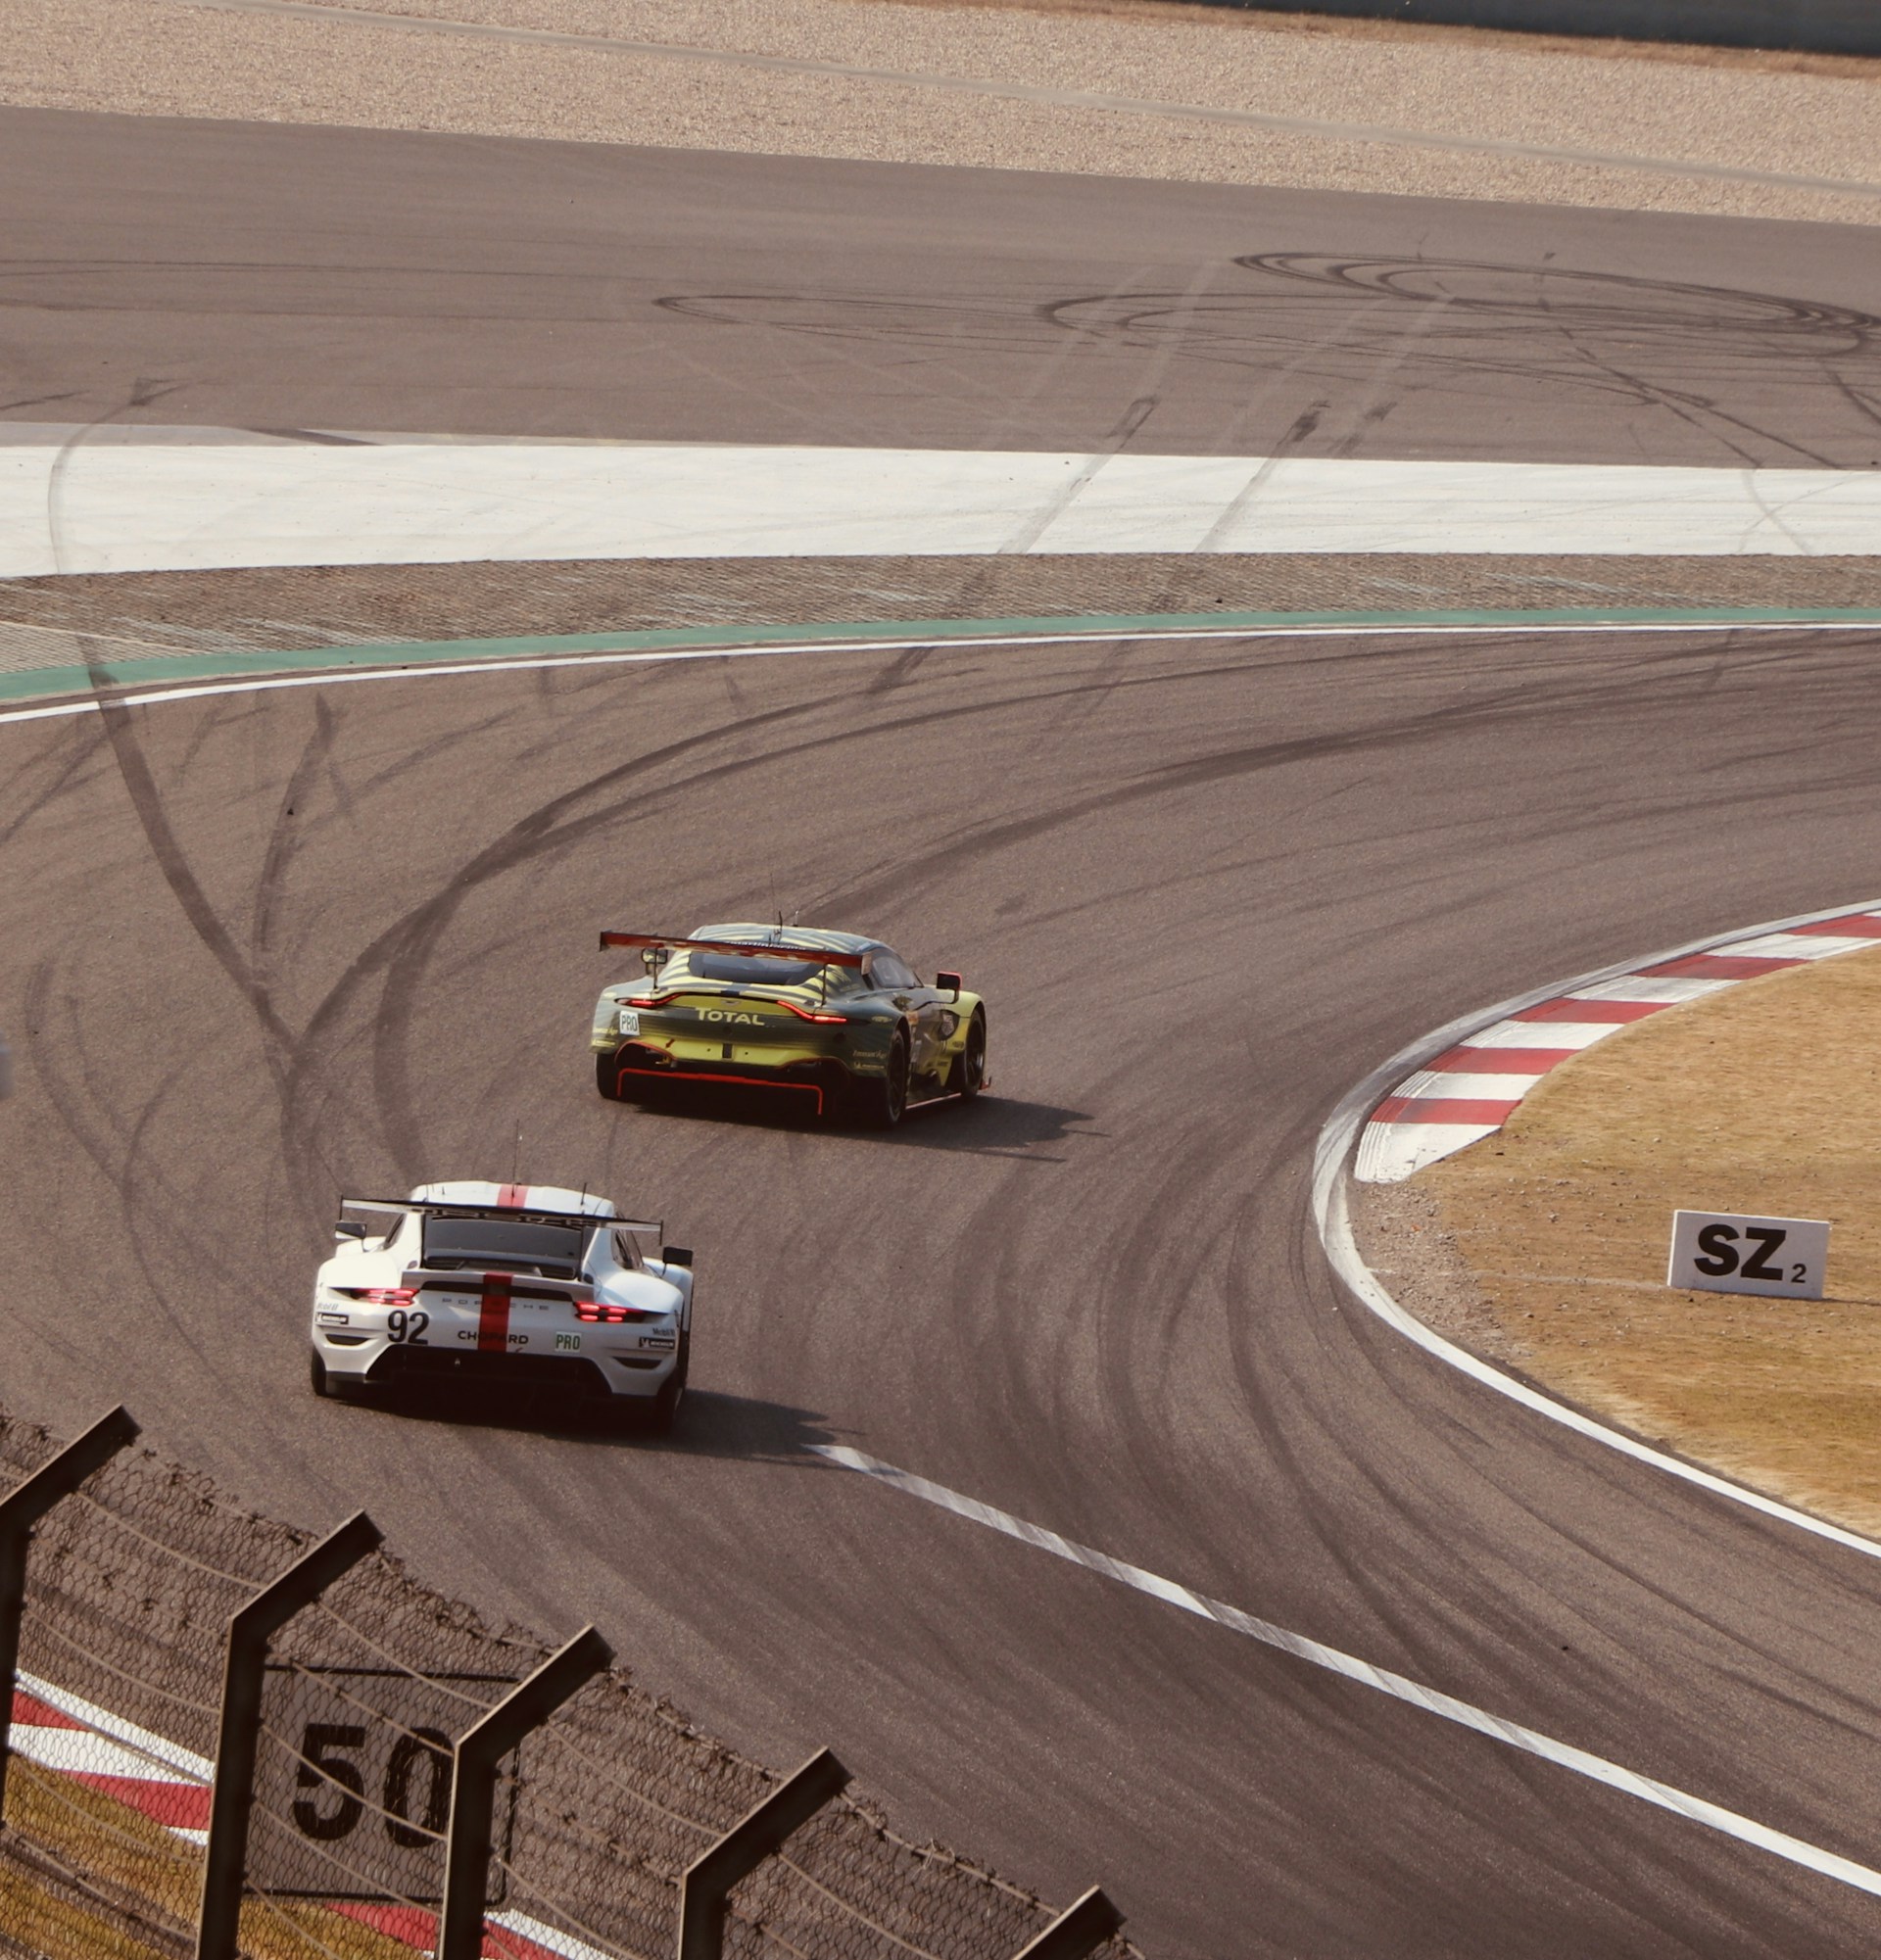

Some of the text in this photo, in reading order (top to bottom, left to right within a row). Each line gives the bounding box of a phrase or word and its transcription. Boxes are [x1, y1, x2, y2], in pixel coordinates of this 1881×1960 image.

[621, 1015, 638, 1032] PRO
[695, 1007, 765, 1027] TOTAL
[387, 1309, 431, 1346] 92
[458, 1329, 529, 1346] CHOPARD
[555, 1334, 581, 1351] PRO
[294, 1723, 455, 1848] 50
